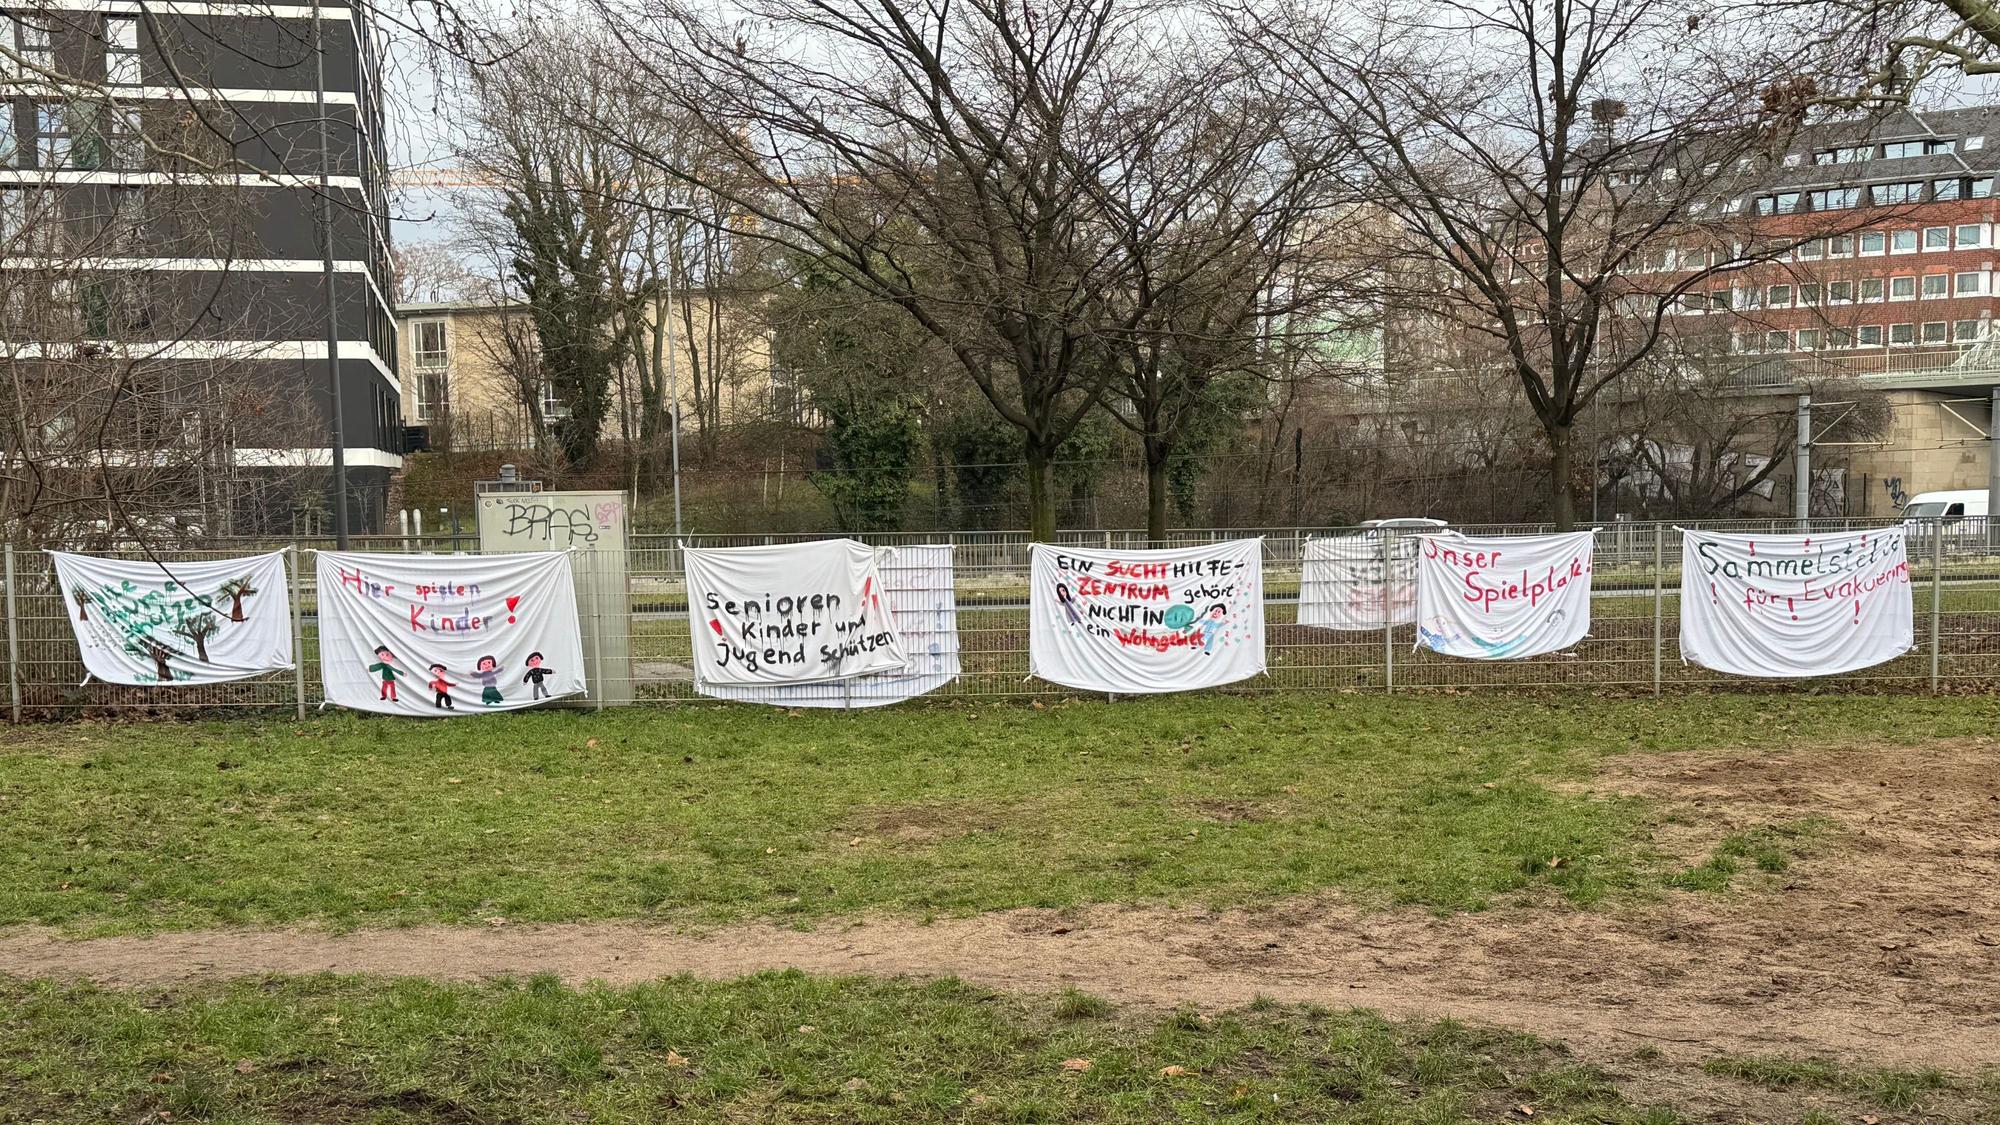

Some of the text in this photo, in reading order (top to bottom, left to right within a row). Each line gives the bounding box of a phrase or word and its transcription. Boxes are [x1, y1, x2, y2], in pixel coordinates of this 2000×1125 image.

[1057, 555, 1093, 572] EIN
[1422, 538, 1502, 568] Unser
[340, 568, 481, 601] Hier spielen
[1077, 576, 1234, 604] ZENTRUM gehört
[706, 592, 841, 616] Senioren
[1743, 588, 1780, 612] für
[742, 620, 821, 640] Kinder
[1087, 624, 1110, 638] ein
